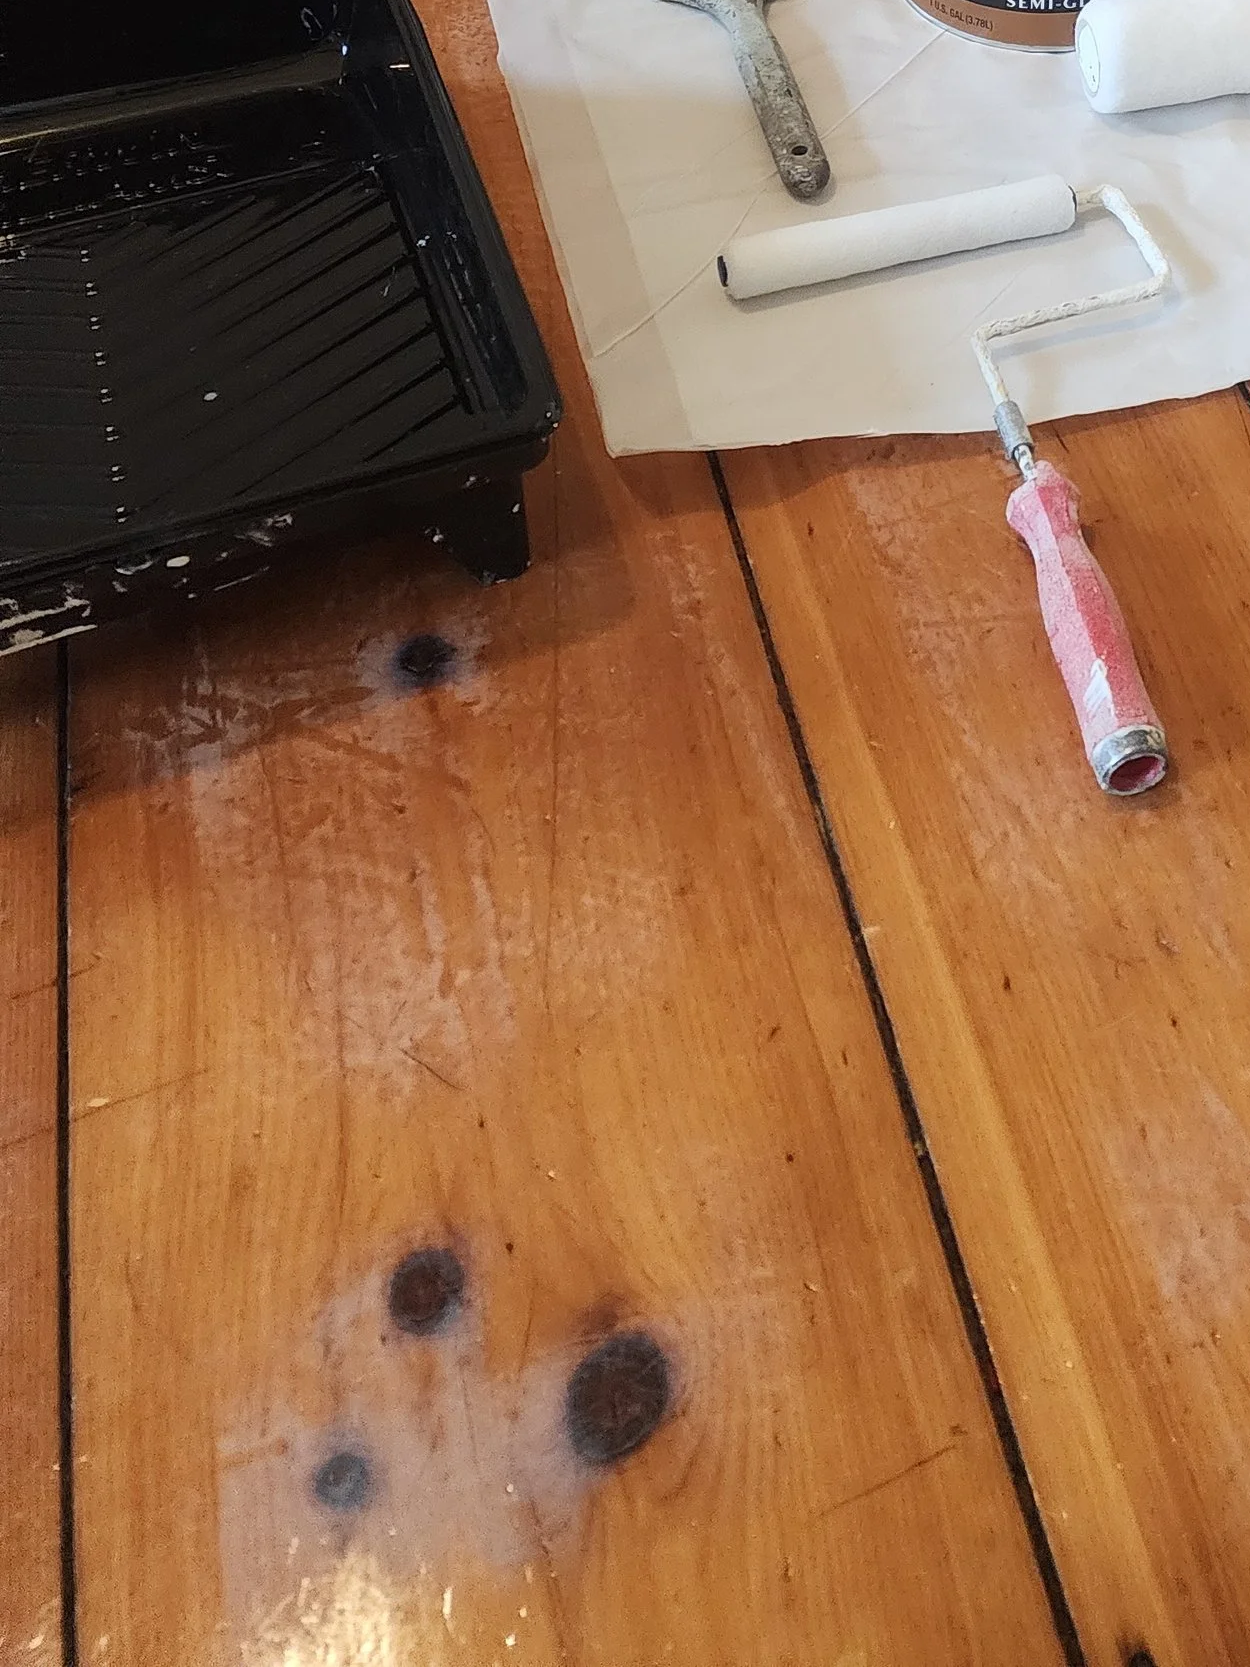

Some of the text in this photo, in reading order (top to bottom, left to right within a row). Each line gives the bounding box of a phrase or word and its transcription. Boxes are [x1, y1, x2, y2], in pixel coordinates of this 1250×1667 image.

[934, 1, 948, 15] U.S.
[949, 7, 965, 23] GAL
[965, 14, 994, 32] (3.78L)
